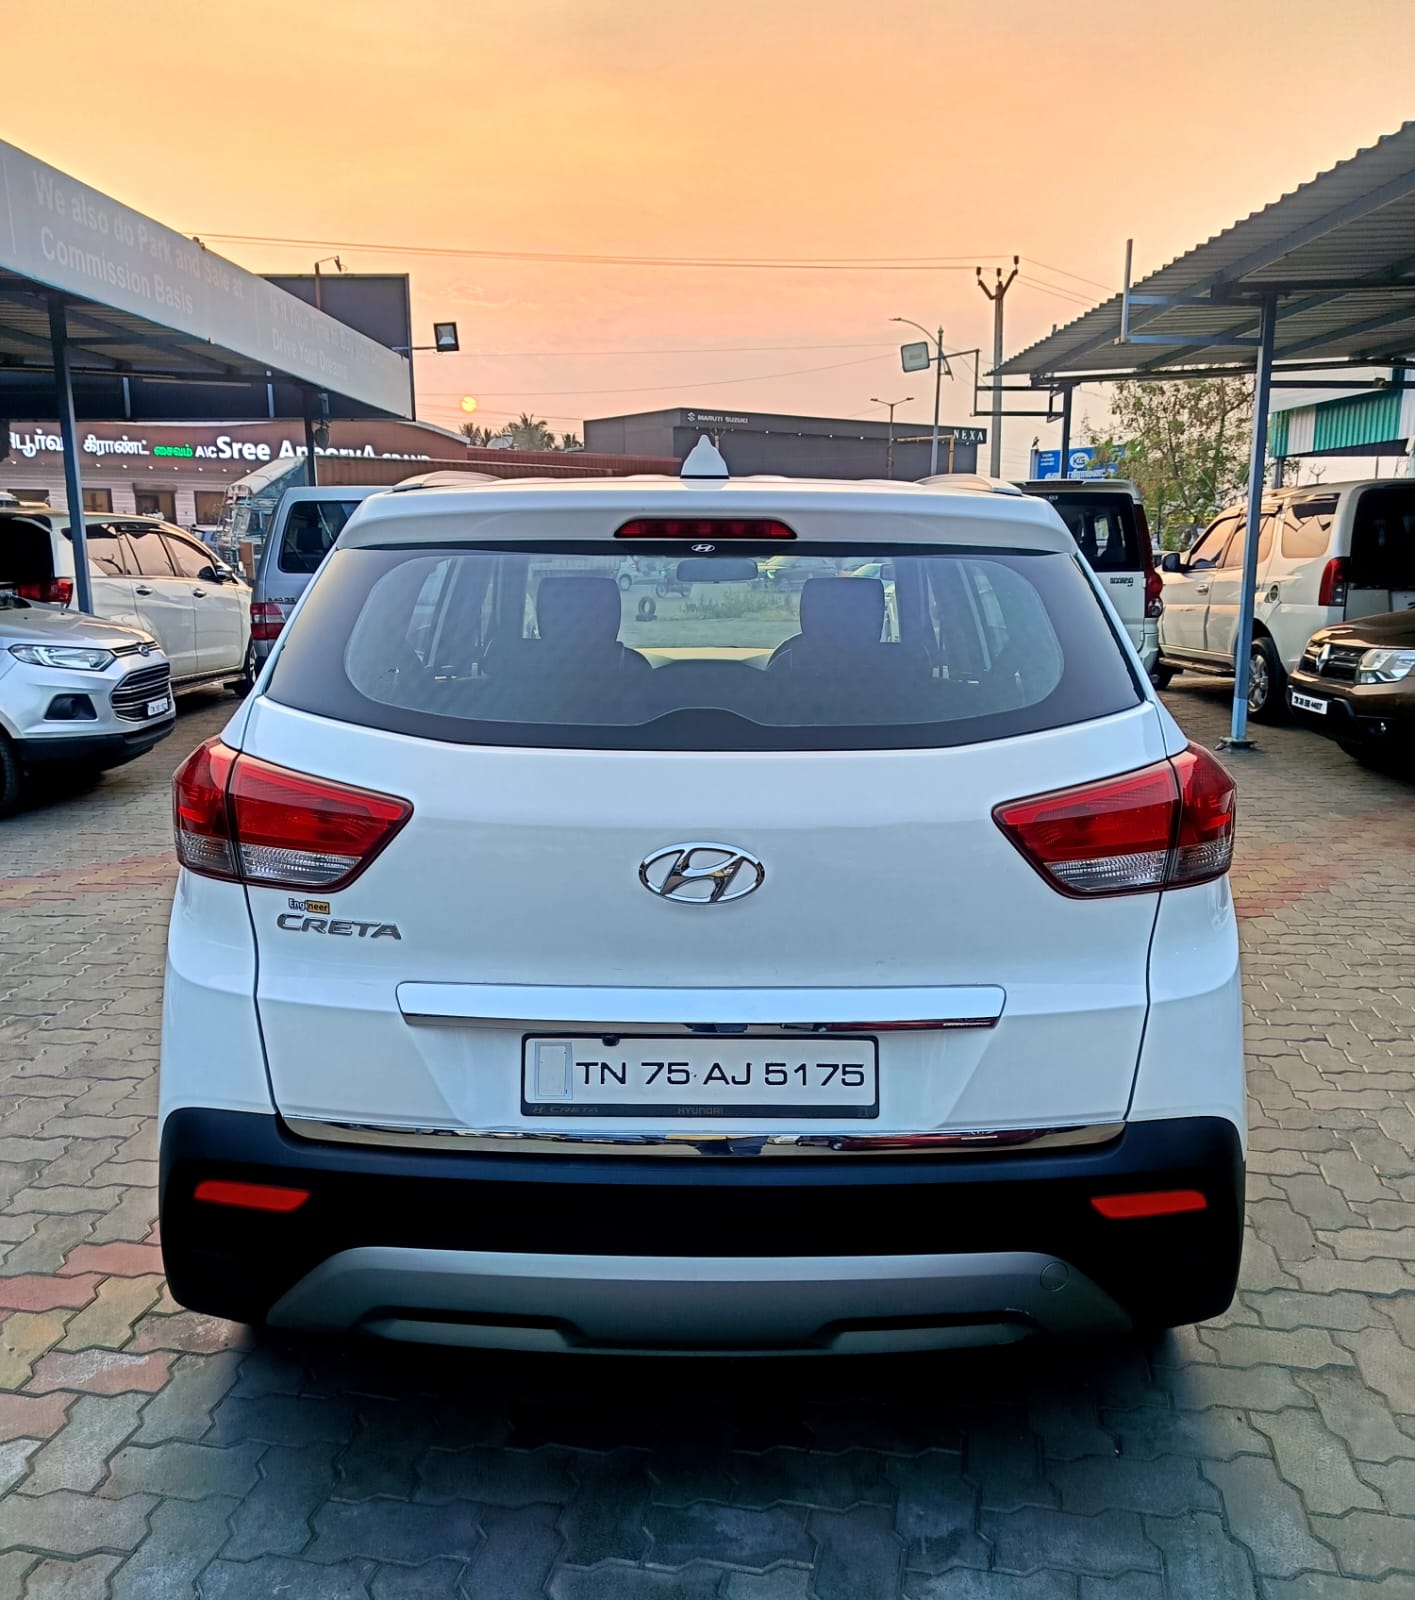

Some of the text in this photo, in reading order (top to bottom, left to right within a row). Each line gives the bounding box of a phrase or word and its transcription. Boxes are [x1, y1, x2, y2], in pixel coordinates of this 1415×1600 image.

[33, 170, 65, 215] We
[72, 194, 108, 235] also
[114, 216, 134, 247] do
[138, 224, 172, 265] Park
[176, 248, 201, 278] and
[232, 276, 245, 300] at
[41, 226, 193, 315] Commission Basis
[83, 434, 150, 456] கிராண்ட்
[953, 429, 984, 441] NEXA
[216, 436, 271, 460] Sree
[288, 898, 329, 914] Engineer
[276, 913, 402, 940] CRETA
[576, 1062, 865, 1087] TN 75 AJ 5175
